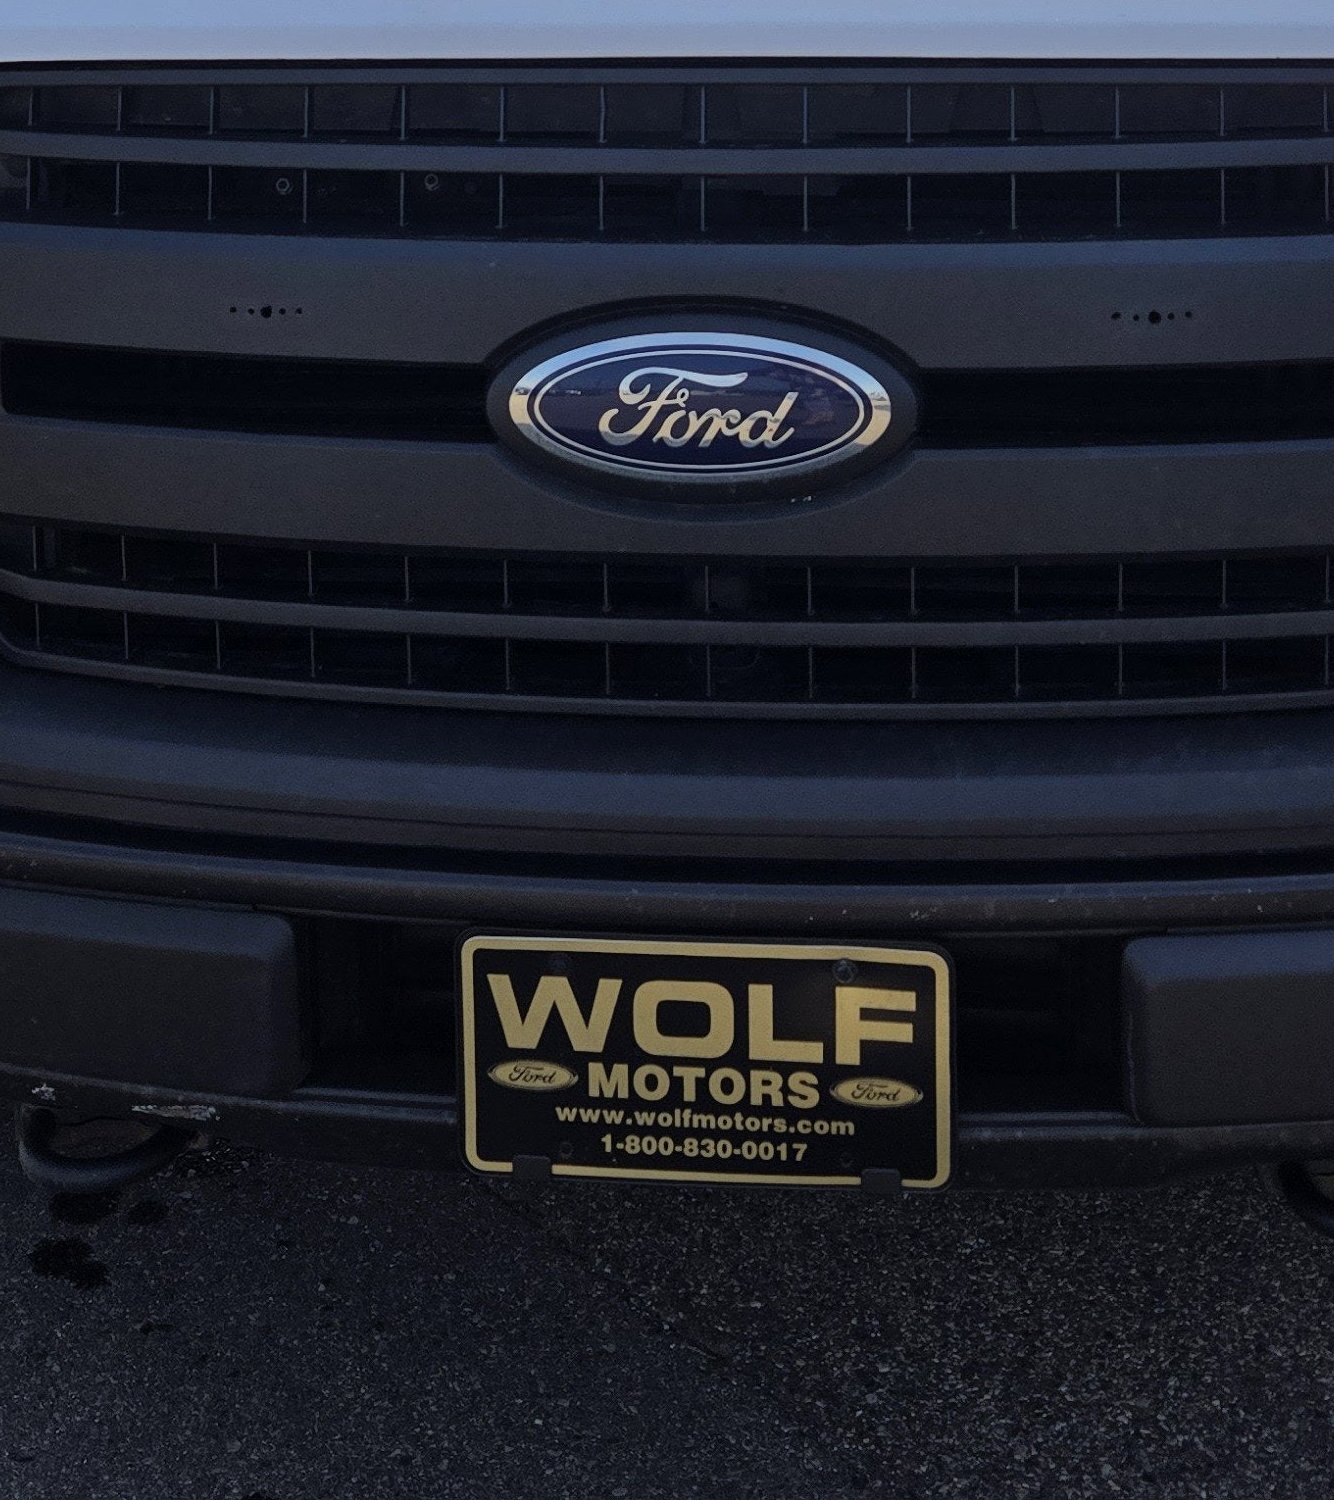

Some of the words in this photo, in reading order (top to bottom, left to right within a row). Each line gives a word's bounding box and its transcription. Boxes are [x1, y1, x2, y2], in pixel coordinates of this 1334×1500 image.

[598, 366, 799, 449] Ford
[486, 973, 917, 1066] WOLF
[507, 1065, 557, 1085] Ford
[587, 1062, 820, 1110] MOTORS
[850, 1081, 901, 1103] Ford
[555, 1105, 855, 1136] www.wolfmotors.com
[601, 1134, 808, 1163] 1-800-830-0017
